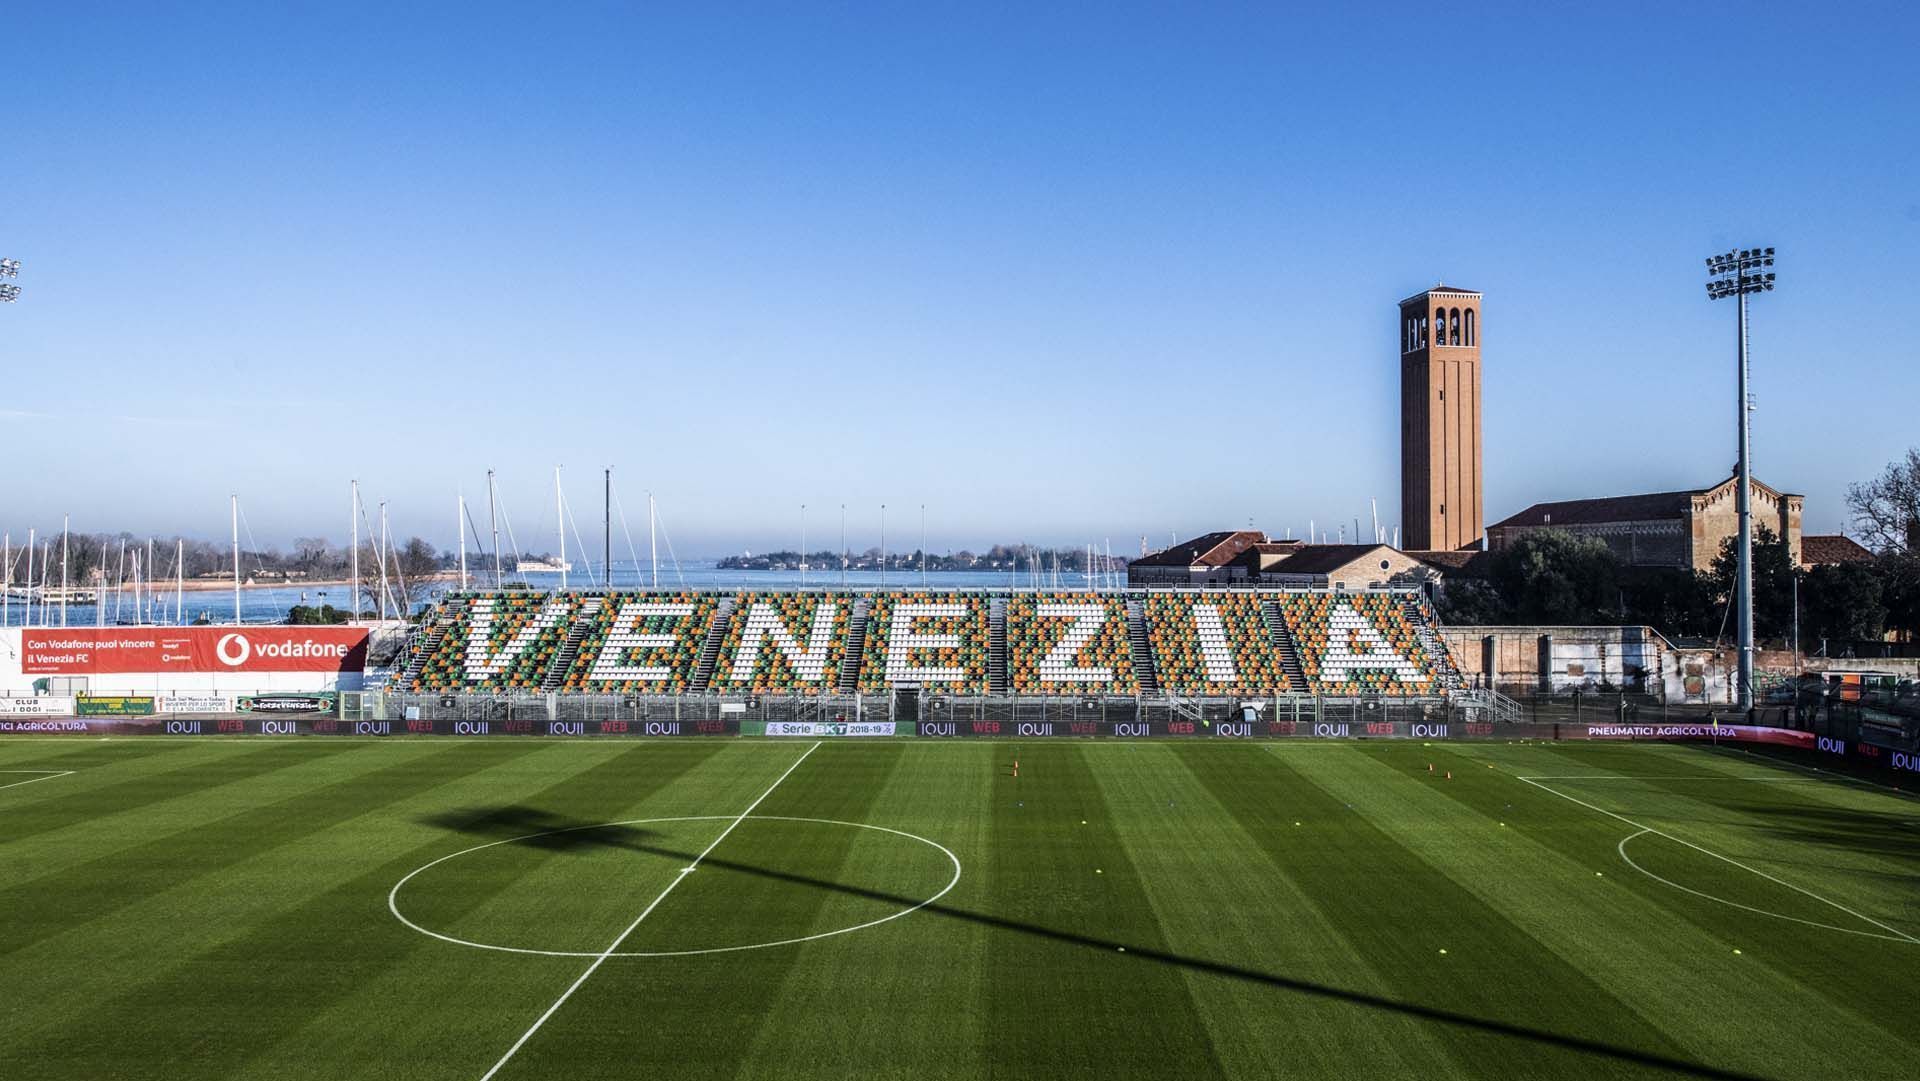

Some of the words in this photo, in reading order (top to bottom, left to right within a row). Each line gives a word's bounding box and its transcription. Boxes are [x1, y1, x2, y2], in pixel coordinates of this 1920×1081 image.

[28, 640, 46, 649] Con
[49, 640, 94, 649] Vodafone
[96, 640, 117, 650] puoi
[120, 639, 155, 648] vincere
[462, 598, 1431, 682] VENEZIA
[255, 640, 348, 657] vodafone
[28, 654, 34, 663] il
[36, 654, 74, 663] Venezia
[76, 653, 88, 662] FC
[16, 722, 88, 731] AGRICOLTURA
[216, 720, 243, 731] WEB
[407, 721, 432, 732] WEB
[601, 721, 628, 732] WEB
[782, 722, 811, 734] Serie
[814, 723, 848, 735] BKT
[850, 725, 882, 734] 2018-19
[973, 721, 1000, 733] WEB
[1071, 722, 1097, 733] WEB
[1168, 722, 1194, 734] WEB
[1366, 722, 1393, 734] WEB
[1588, 727, 1654, 736] PNEUMATICI
[1656, 727, 1737, 737] AGRICOLTURA
